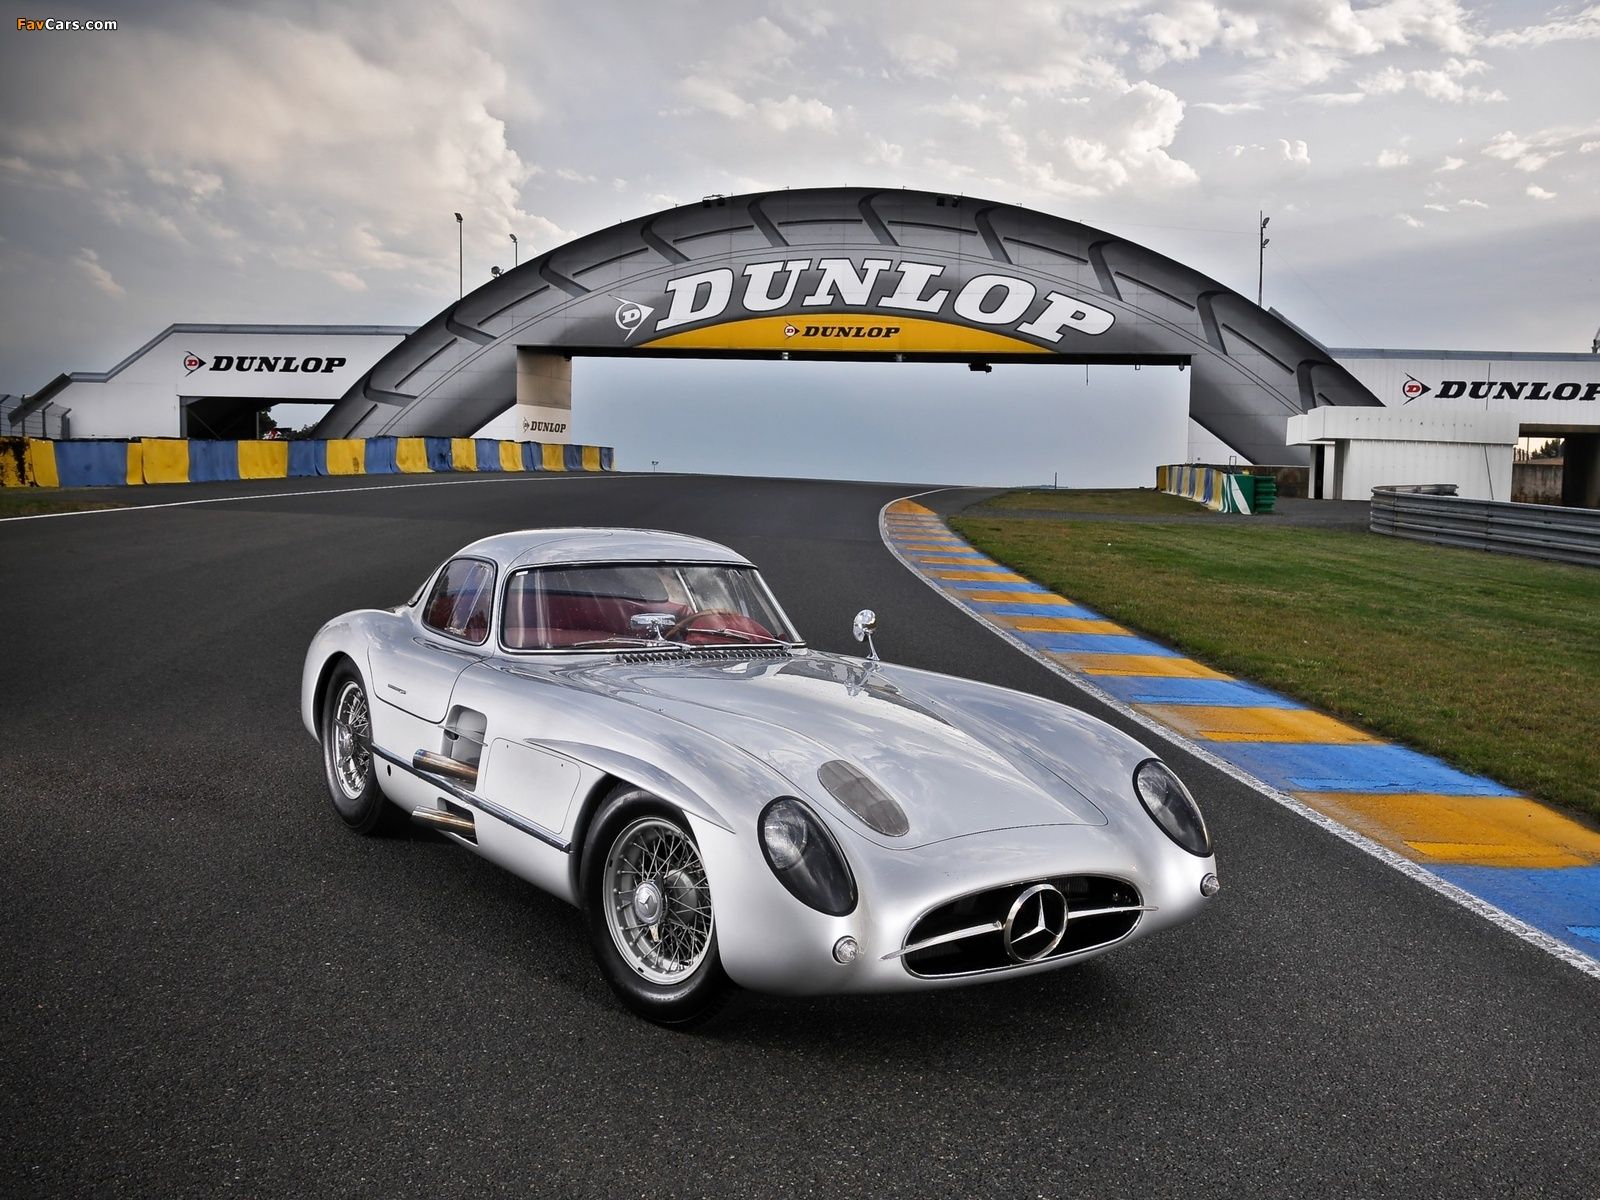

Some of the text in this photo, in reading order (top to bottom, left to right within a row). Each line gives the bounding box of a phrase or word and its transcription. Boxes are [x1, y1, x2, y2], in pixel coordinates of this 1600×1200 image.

[654, 257, 1116, 344] DUNLOP
[801, 326, 900, 338] DUNLOP
[209, 356, 347, 373] DUNLOP
[530, 421, 567, 433] DUNLOP
